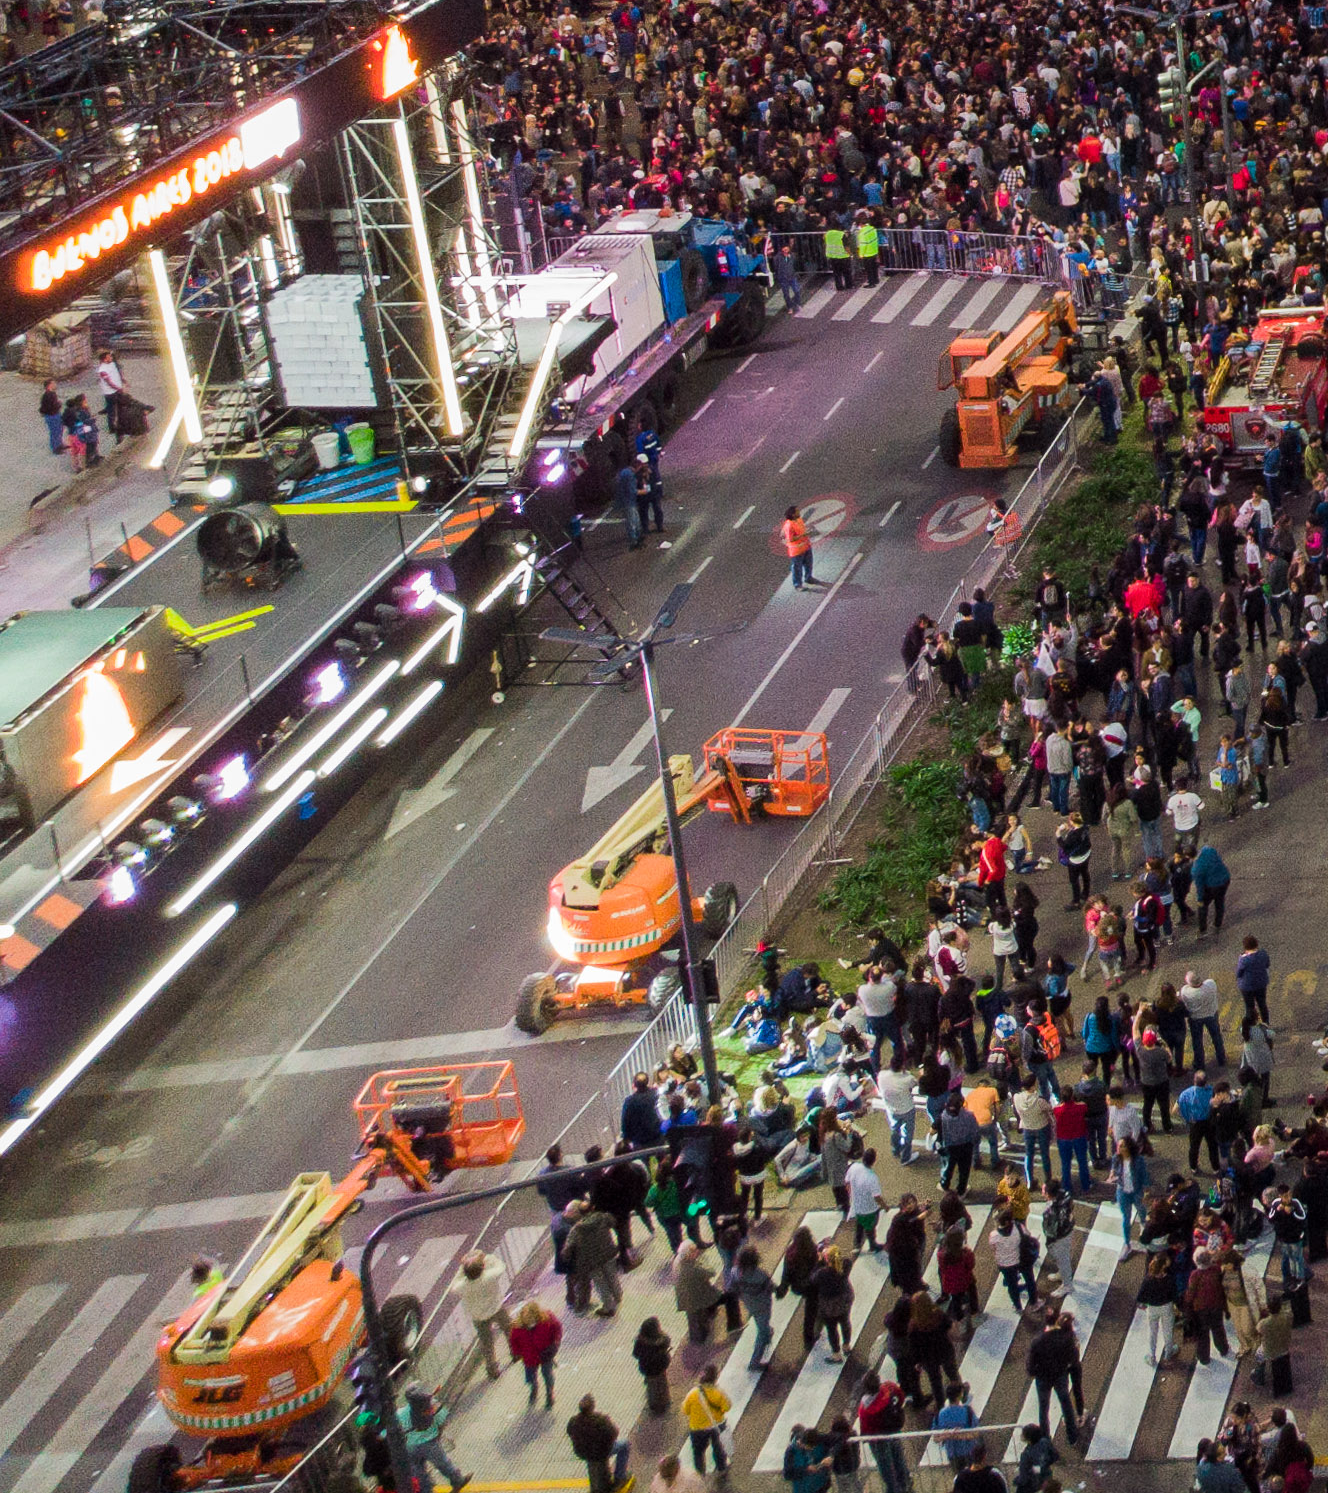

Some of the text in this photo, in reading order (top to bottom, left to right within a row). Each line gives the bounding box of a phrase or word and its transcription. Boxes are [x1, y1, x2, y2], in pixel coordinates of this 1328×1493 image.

[32, 136, 245, 291] BUENOS AIRES 2018
